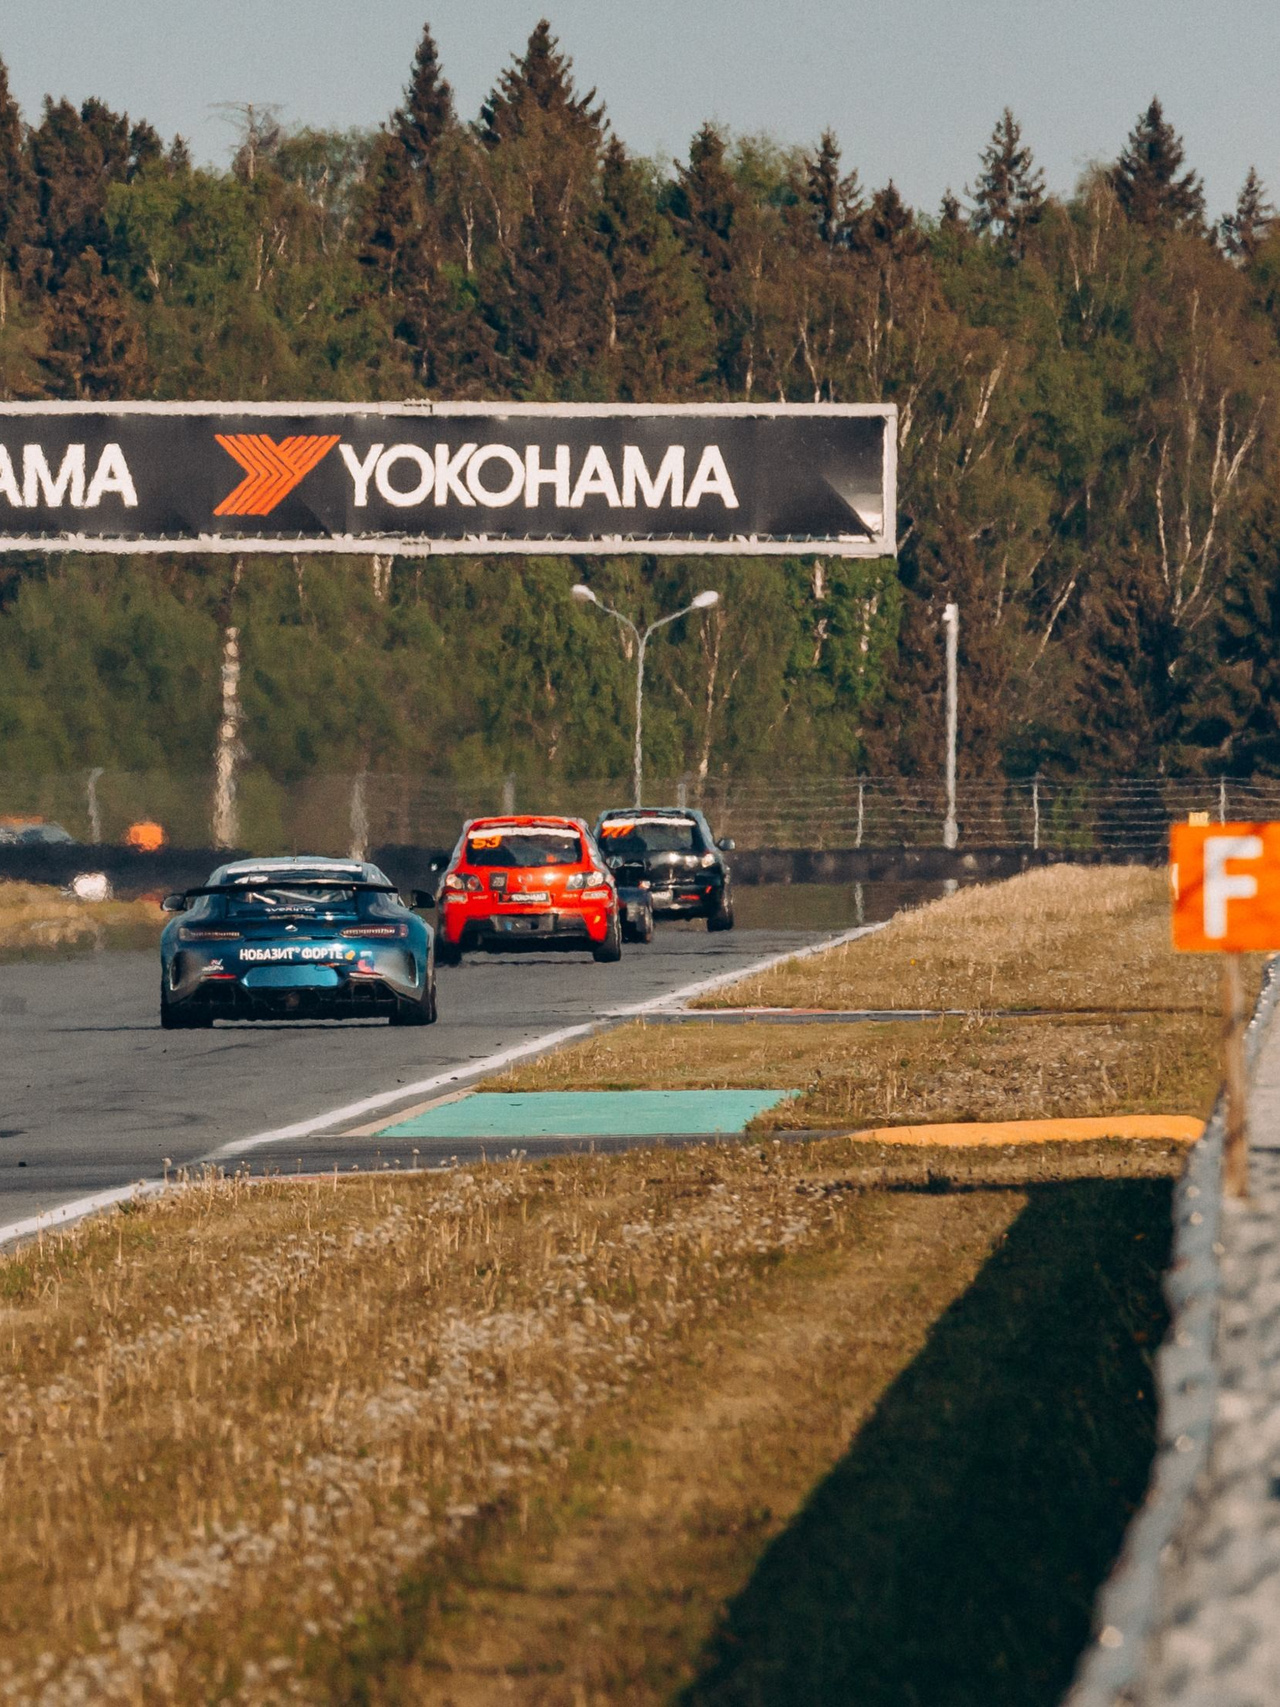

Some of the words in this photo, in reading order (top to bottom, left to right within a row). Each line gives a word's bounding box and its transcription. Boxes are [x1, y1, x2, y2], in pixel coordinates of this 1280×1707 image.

[340, 442, 740, 510] YOKOHAMA
[1203, 835, 1264, 940] F
[301, 946, 344, 960] ФОРТЕ
